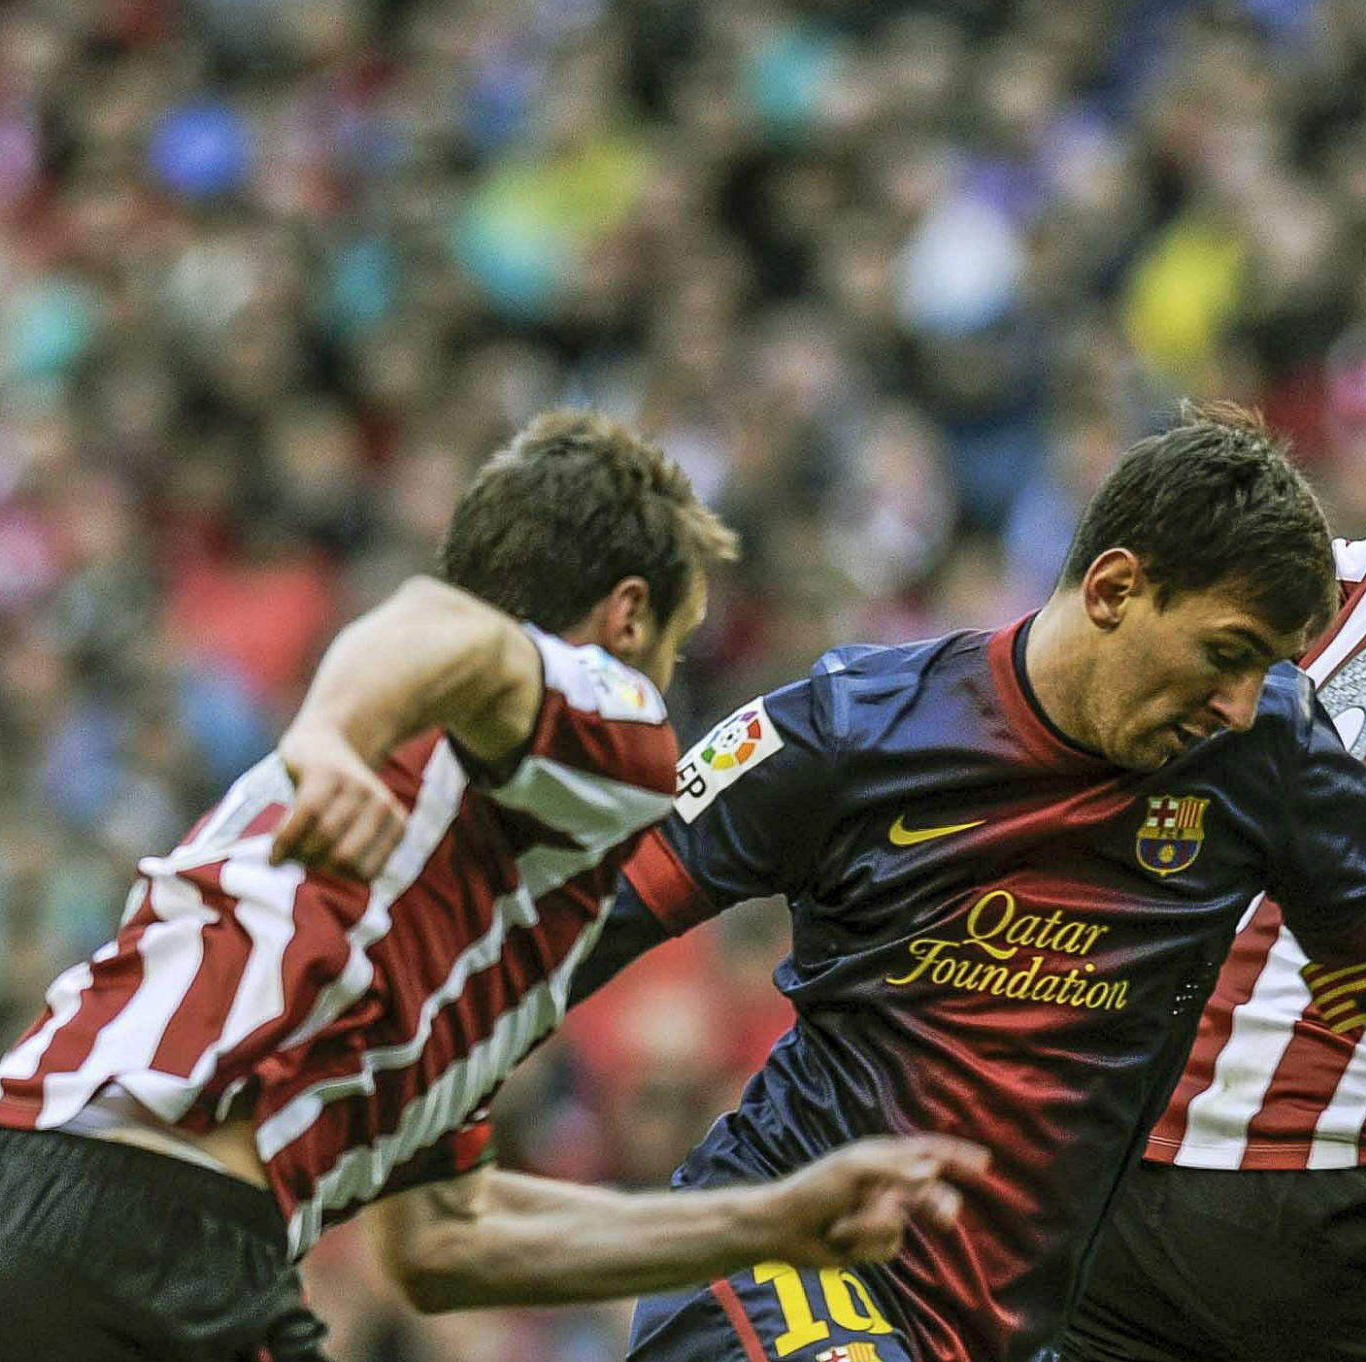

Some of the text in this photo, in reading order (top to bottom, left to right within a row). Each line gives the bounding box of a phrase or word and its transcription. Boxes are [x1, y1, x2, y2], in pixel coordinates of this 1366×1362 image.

[676, 761, 706, 799] FP
[962, 889, 1111, 960] Qatar
[885, 938, 1131, 1010] Foundation
